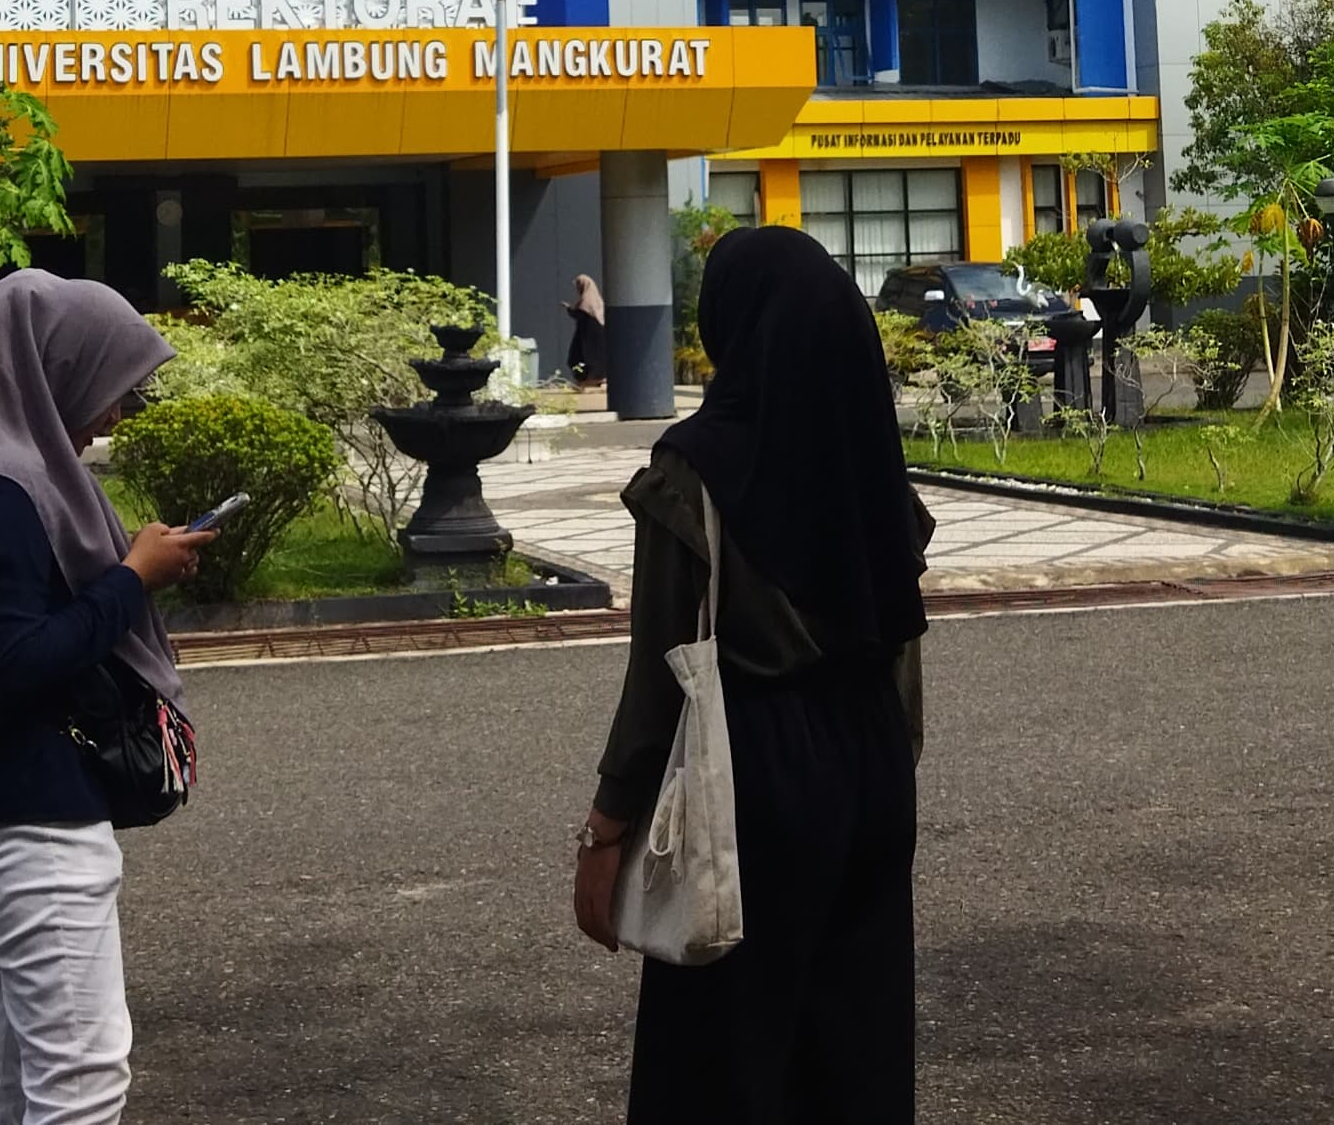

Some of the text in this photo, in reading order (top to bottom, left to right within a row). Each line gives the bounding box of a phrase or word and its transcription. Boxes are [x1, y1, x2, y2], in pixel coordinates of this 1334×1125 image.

[251, 41, 448, 81] LAMBUNG
[474, 39, 710, 79] MANGKURAT
[811, 134, 841, 148] PUSAT
[844, 134, 896, 148] INFORMASI
[899, 133, 917, 147] DAN
[977, 131, 1021, 146] TERPADU
